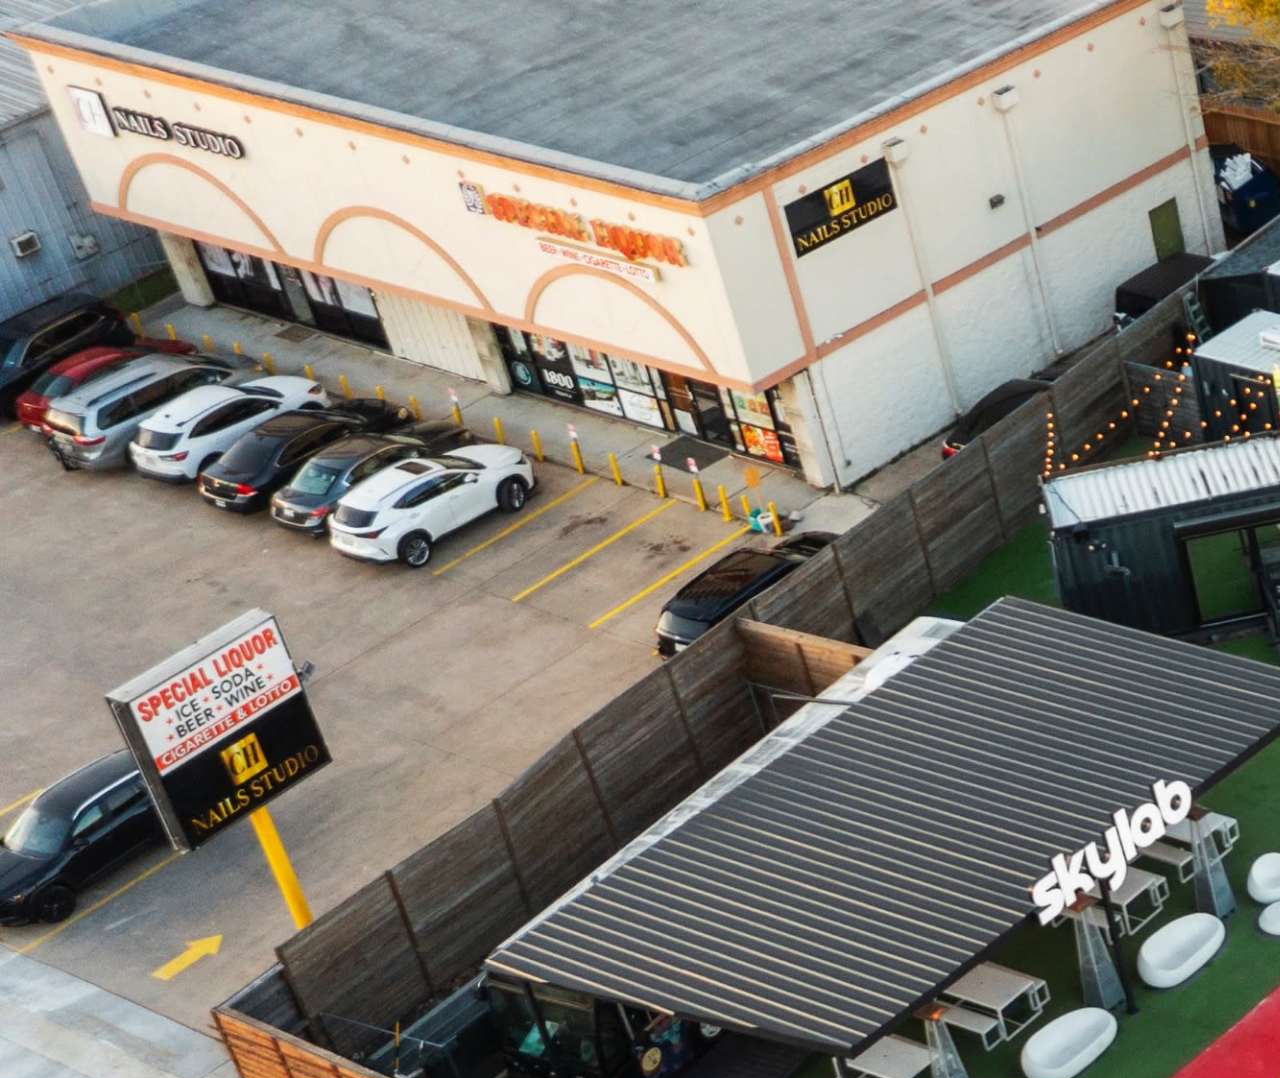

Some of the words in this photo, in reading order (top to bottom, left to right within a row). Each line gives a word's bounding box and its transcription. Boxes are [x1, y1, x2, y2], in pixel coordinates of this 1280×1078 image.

[113, 107, 171, 139] NAILS
[172, 123, 246, 159] STUDIO
[797, 218, 841, 251] NAILS
[841, 192, 893, 229] STUDIO
[543, 368, 574, 389] 1800
[137, 667, 213, 722] SPECIAL
[212, 627, 278, 678] LIQUOR
[175, 697, 202, 722] ICE
[211, 666, 255, 700] SODA
[161, 715, 235, 766] CIGARETTE
[249, 678, 293, 713] LOTTO
[175, 707, 216, 739] BEER
[224, 676, 267, 708] WINE
[192, 788, 251, 831] NAILS
[250, 744, 319, 799] STUDIO
[229, 740, 260, 776] CH
[1032, 779, 1192, 926] skylab
